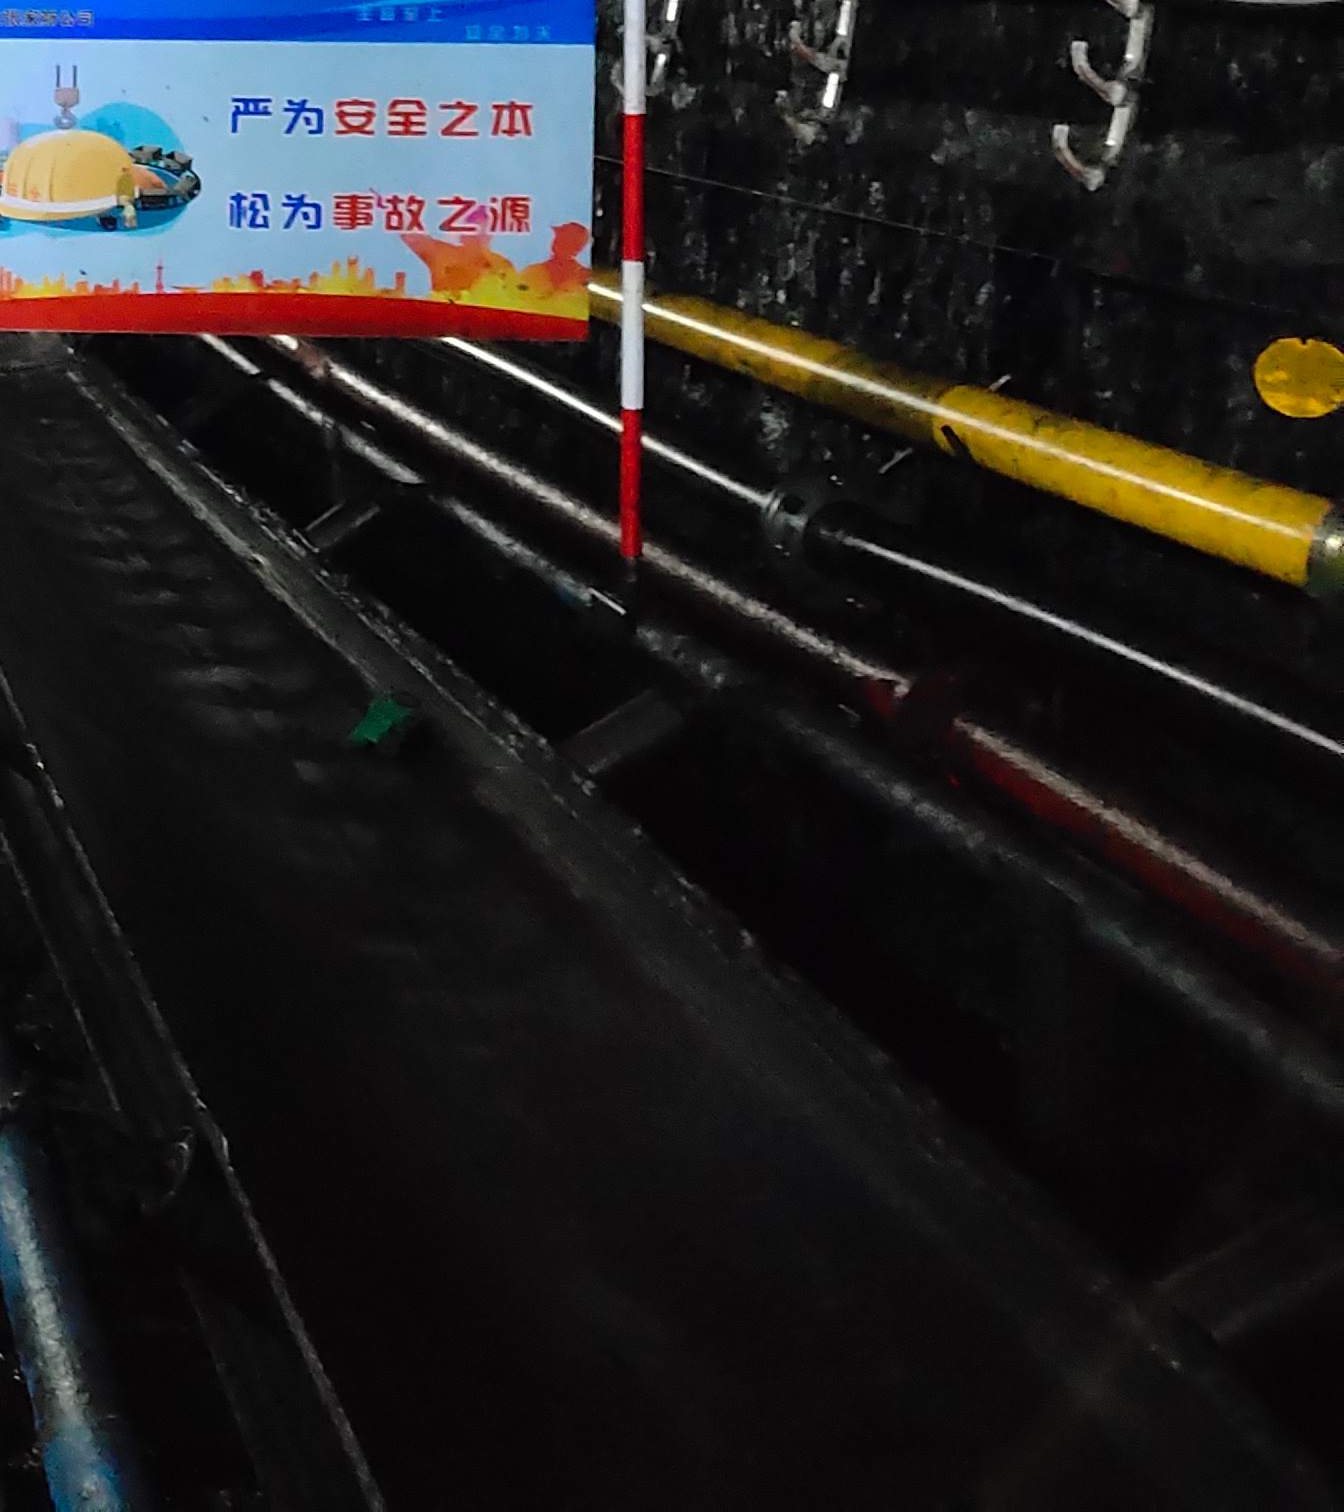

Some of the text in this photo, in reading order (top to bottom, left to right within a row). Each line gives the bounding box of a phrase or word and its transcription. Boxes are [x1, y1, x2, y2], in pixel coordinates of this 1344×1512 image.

[230, 97, 533, 137] 严为安全之本
[228, 192, 531, 233] 松为事故之源
